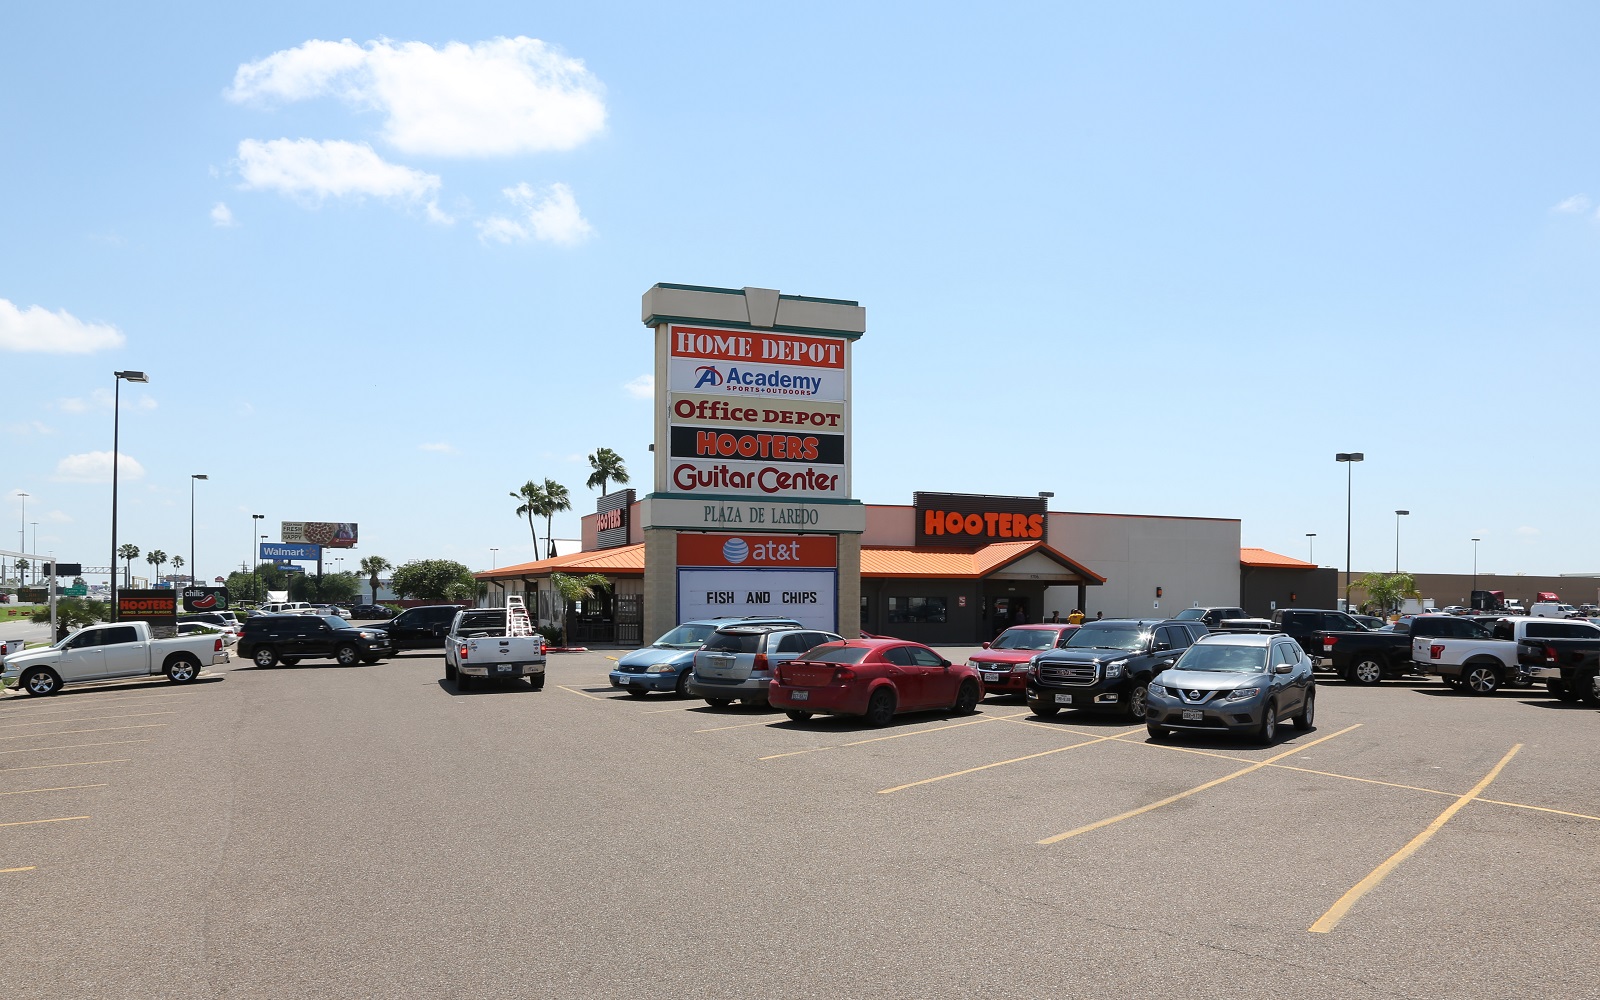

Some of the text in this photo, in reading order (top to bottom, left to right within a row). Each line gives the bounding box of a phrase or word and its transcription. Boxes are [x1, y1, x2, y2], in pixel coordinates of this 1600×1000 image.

[676, 332, 841, 364] HOME DEPOT
[726, 367, 821, 395] Academy
[674, 399, 841, 427] Office DEPOT
[696, 430, 820, 461] HOOTERS
[673, 463, 839, 493] Guitar Center
[596, 508, 621, 532] HOOTERS
[703, 505, 819, 525] PLAZA DE LAREDO
[925, 509, 1044, 538] HOOTERS
[263, 547, 304, 557] Walmart
[752, 540, 800, 561] at&t
[120, 601, 174, 610] HOOTERS
[706, 591, 817, 604] FISH AND CHIPS
